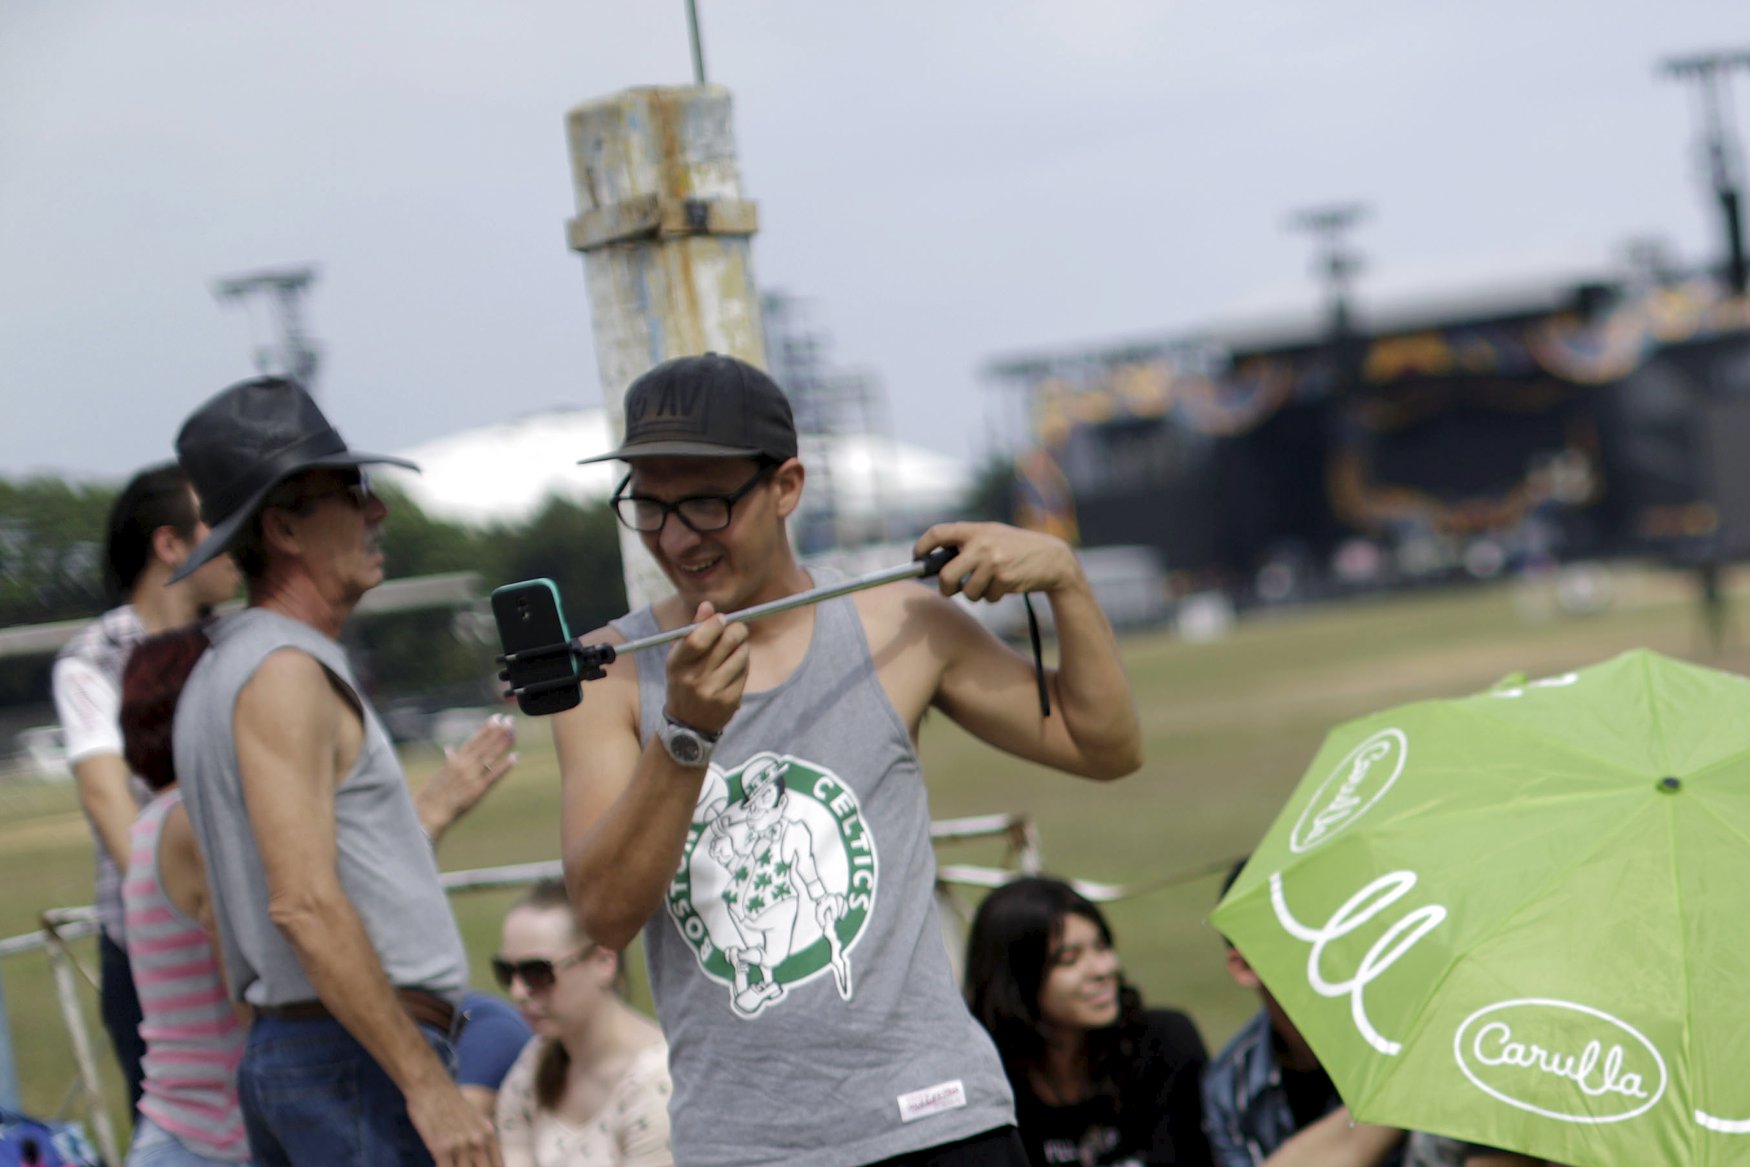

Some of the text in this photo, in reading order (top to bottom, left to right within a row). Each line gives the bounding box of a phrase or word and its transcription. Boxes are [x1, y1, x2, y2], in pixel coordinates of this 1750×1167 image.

[670, 830, 713, 963] BOST
[813, 776, 873, 912] CELTICS
[1473, 1021, 1648, 1099] Carulla
